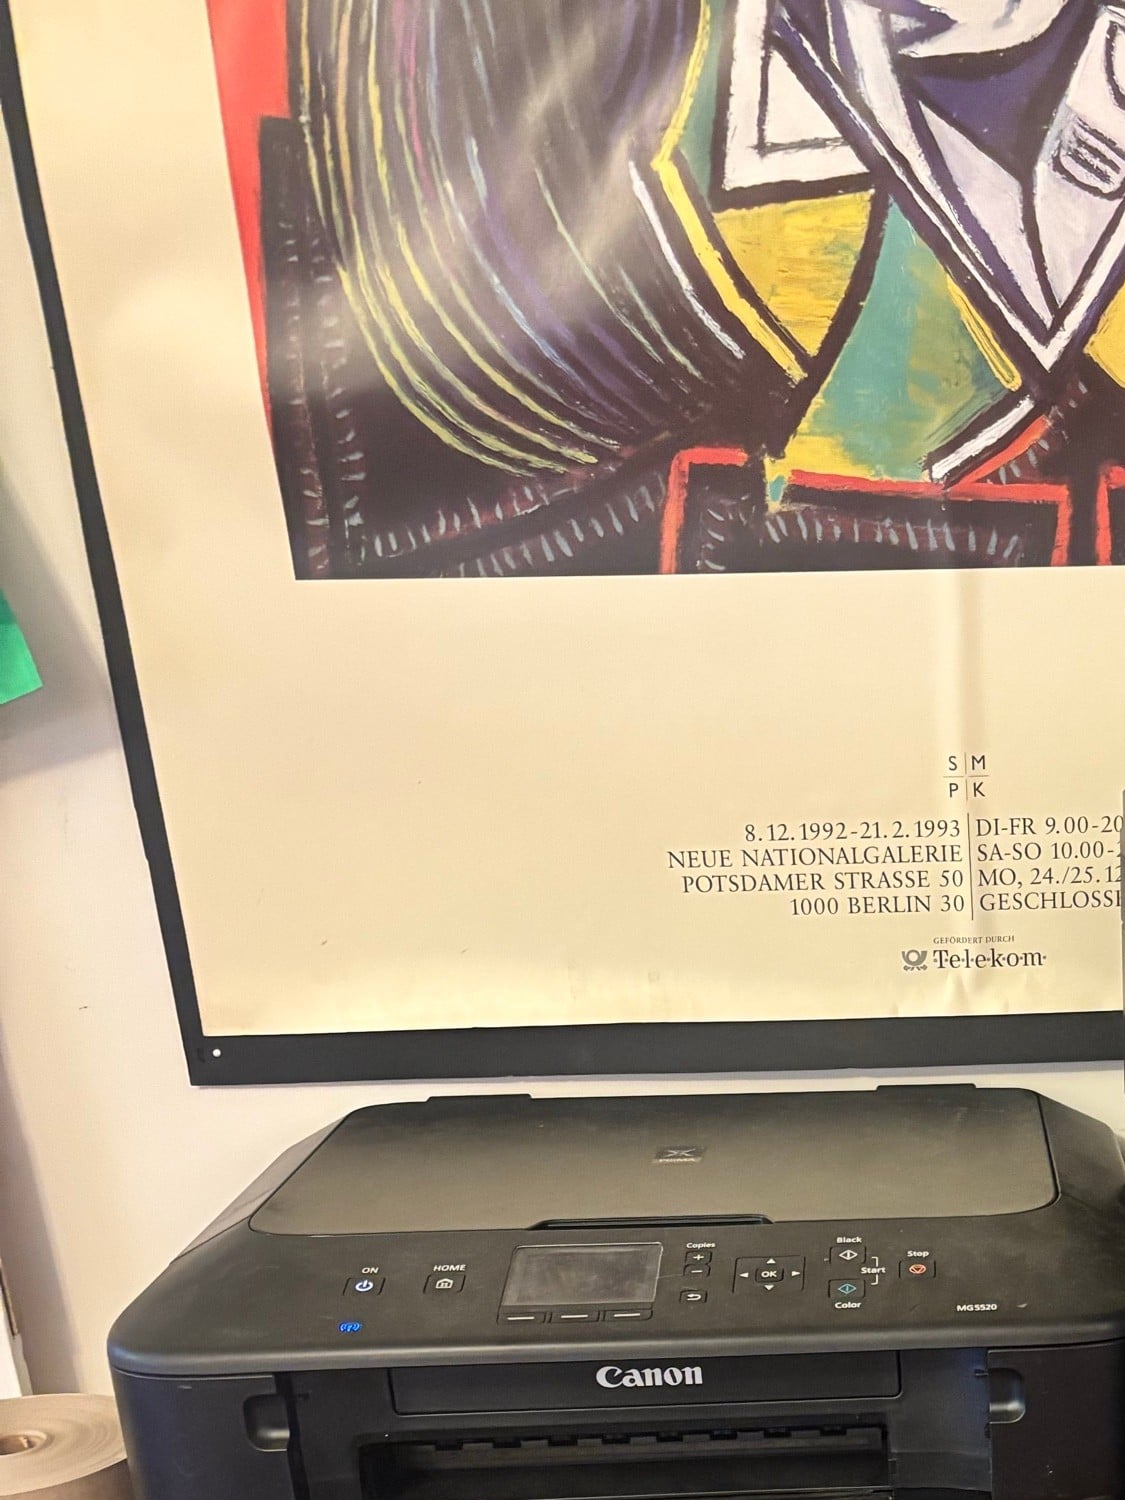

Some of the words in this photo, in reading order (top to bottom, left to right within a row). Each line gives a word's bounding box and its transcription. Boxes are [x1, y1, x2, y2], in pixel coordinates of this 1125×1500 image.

[948, 756, 958, 771] S
[971, 755, 986, 770] M
[949, 783, 958, 797] P
[973, 782, 985, 797] K
[976, 818, 1037, 837] DI-FR
[667, 850, 732, 870] NEUE
[742, 845, 962, 867] NATIONALGALERIE
[977, 842, 1042, 861] SA-SO
[1051, 840, 1121, 860] 10.00-
[682, 873, 825, 894] POTSDAMER
[834, 871, 930, 889] STRASSE
[938, 870, 964, 888] 50
[978, 869, 1023, 888] MO,
[790, 898, 839, 916] 1000
[848, 896, 931, 915] BERLIN
[940, 895, 964, 913] 30
[933, 937, 982, 945] GEFÖRDERT
[985, 935, 1015, 943] DURCH
[907, 1250, 929, 1258] Stop
[433, 1264, 466, 1272] HOME
[761, 1270, 776, 1278] OK
[861, 1266, 886, 1274] Start
[835, 1301, 861, 1309] Color
[957, 1304, 997, 1312] MG5520
[596, 1366, 703, 1388] Canon
